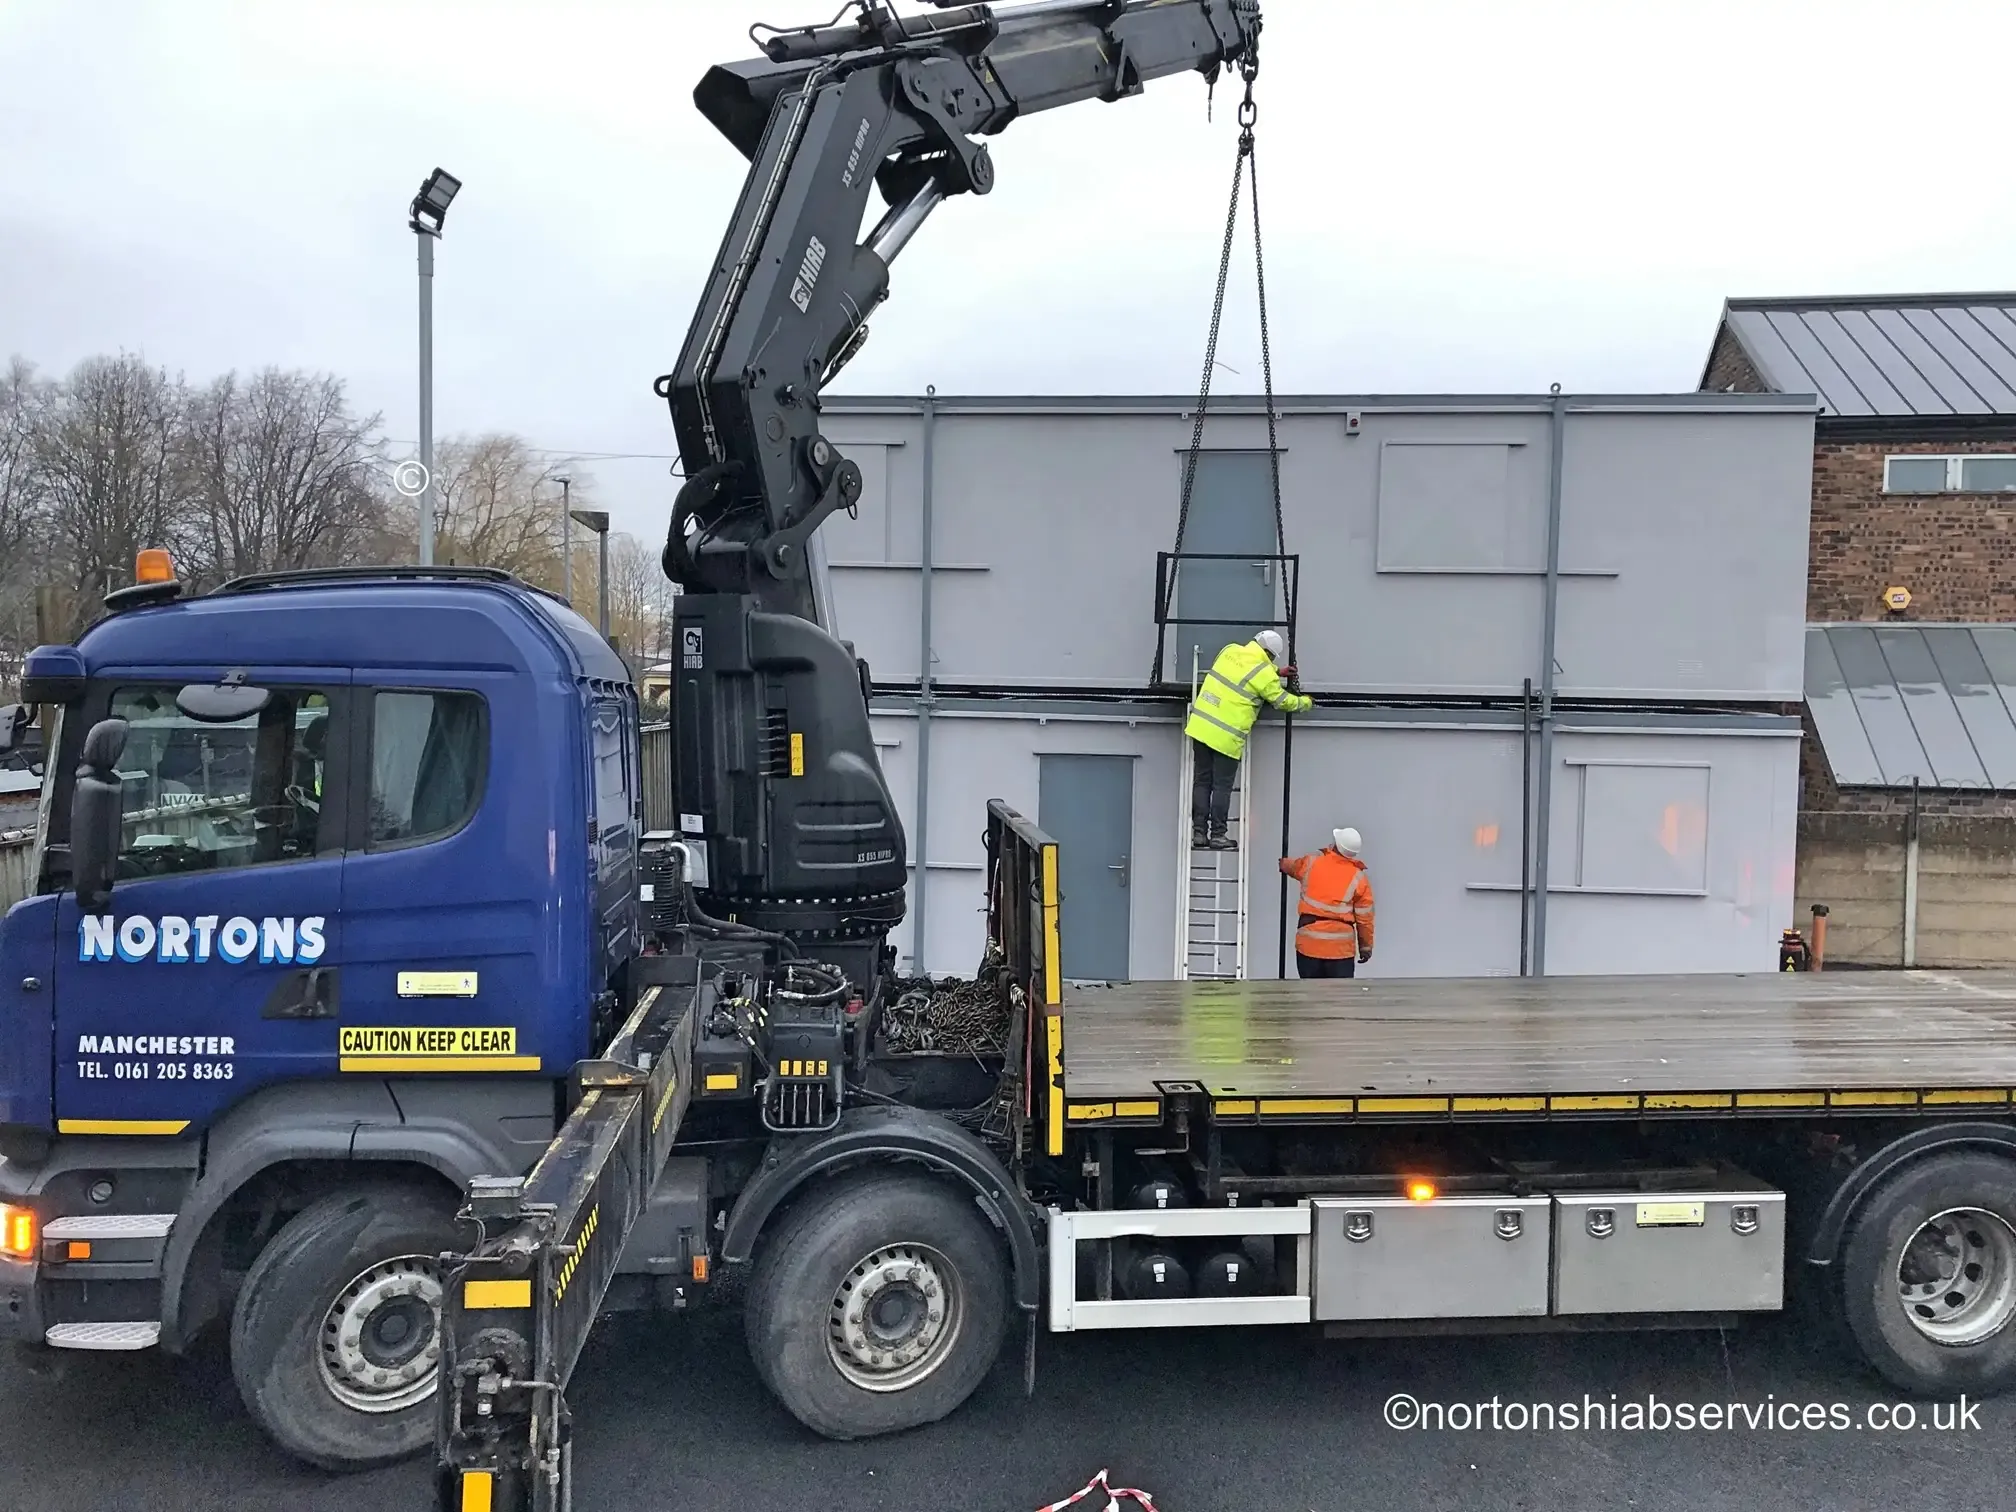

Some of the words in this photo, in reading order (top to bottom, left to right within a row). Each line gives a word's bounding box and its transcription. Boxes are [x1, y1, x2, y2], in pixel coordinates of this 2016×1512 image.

[842, 170, 852, 188] XS
[854, 118, 870, 151] HIPRO
[799, 236, 827, 289] HIAB
[684, 655, 703, 669] HIAB
[78, 914, 326, 964] NORTONS
[78, 1035, 235, 1055] MANCHESTER
[343, 1030, 411, 1051] CAUTION
[416, 1030, 456, 1051] KEEP
[461, 1031, 511, 1051] CLEAR
[78, 1061, 109, 1079] TEL.
[114, 1062, 149, 1080] 0161
[157, 1063, 187, 1080] 205
[192, 1063, 234, 1080] 8363
